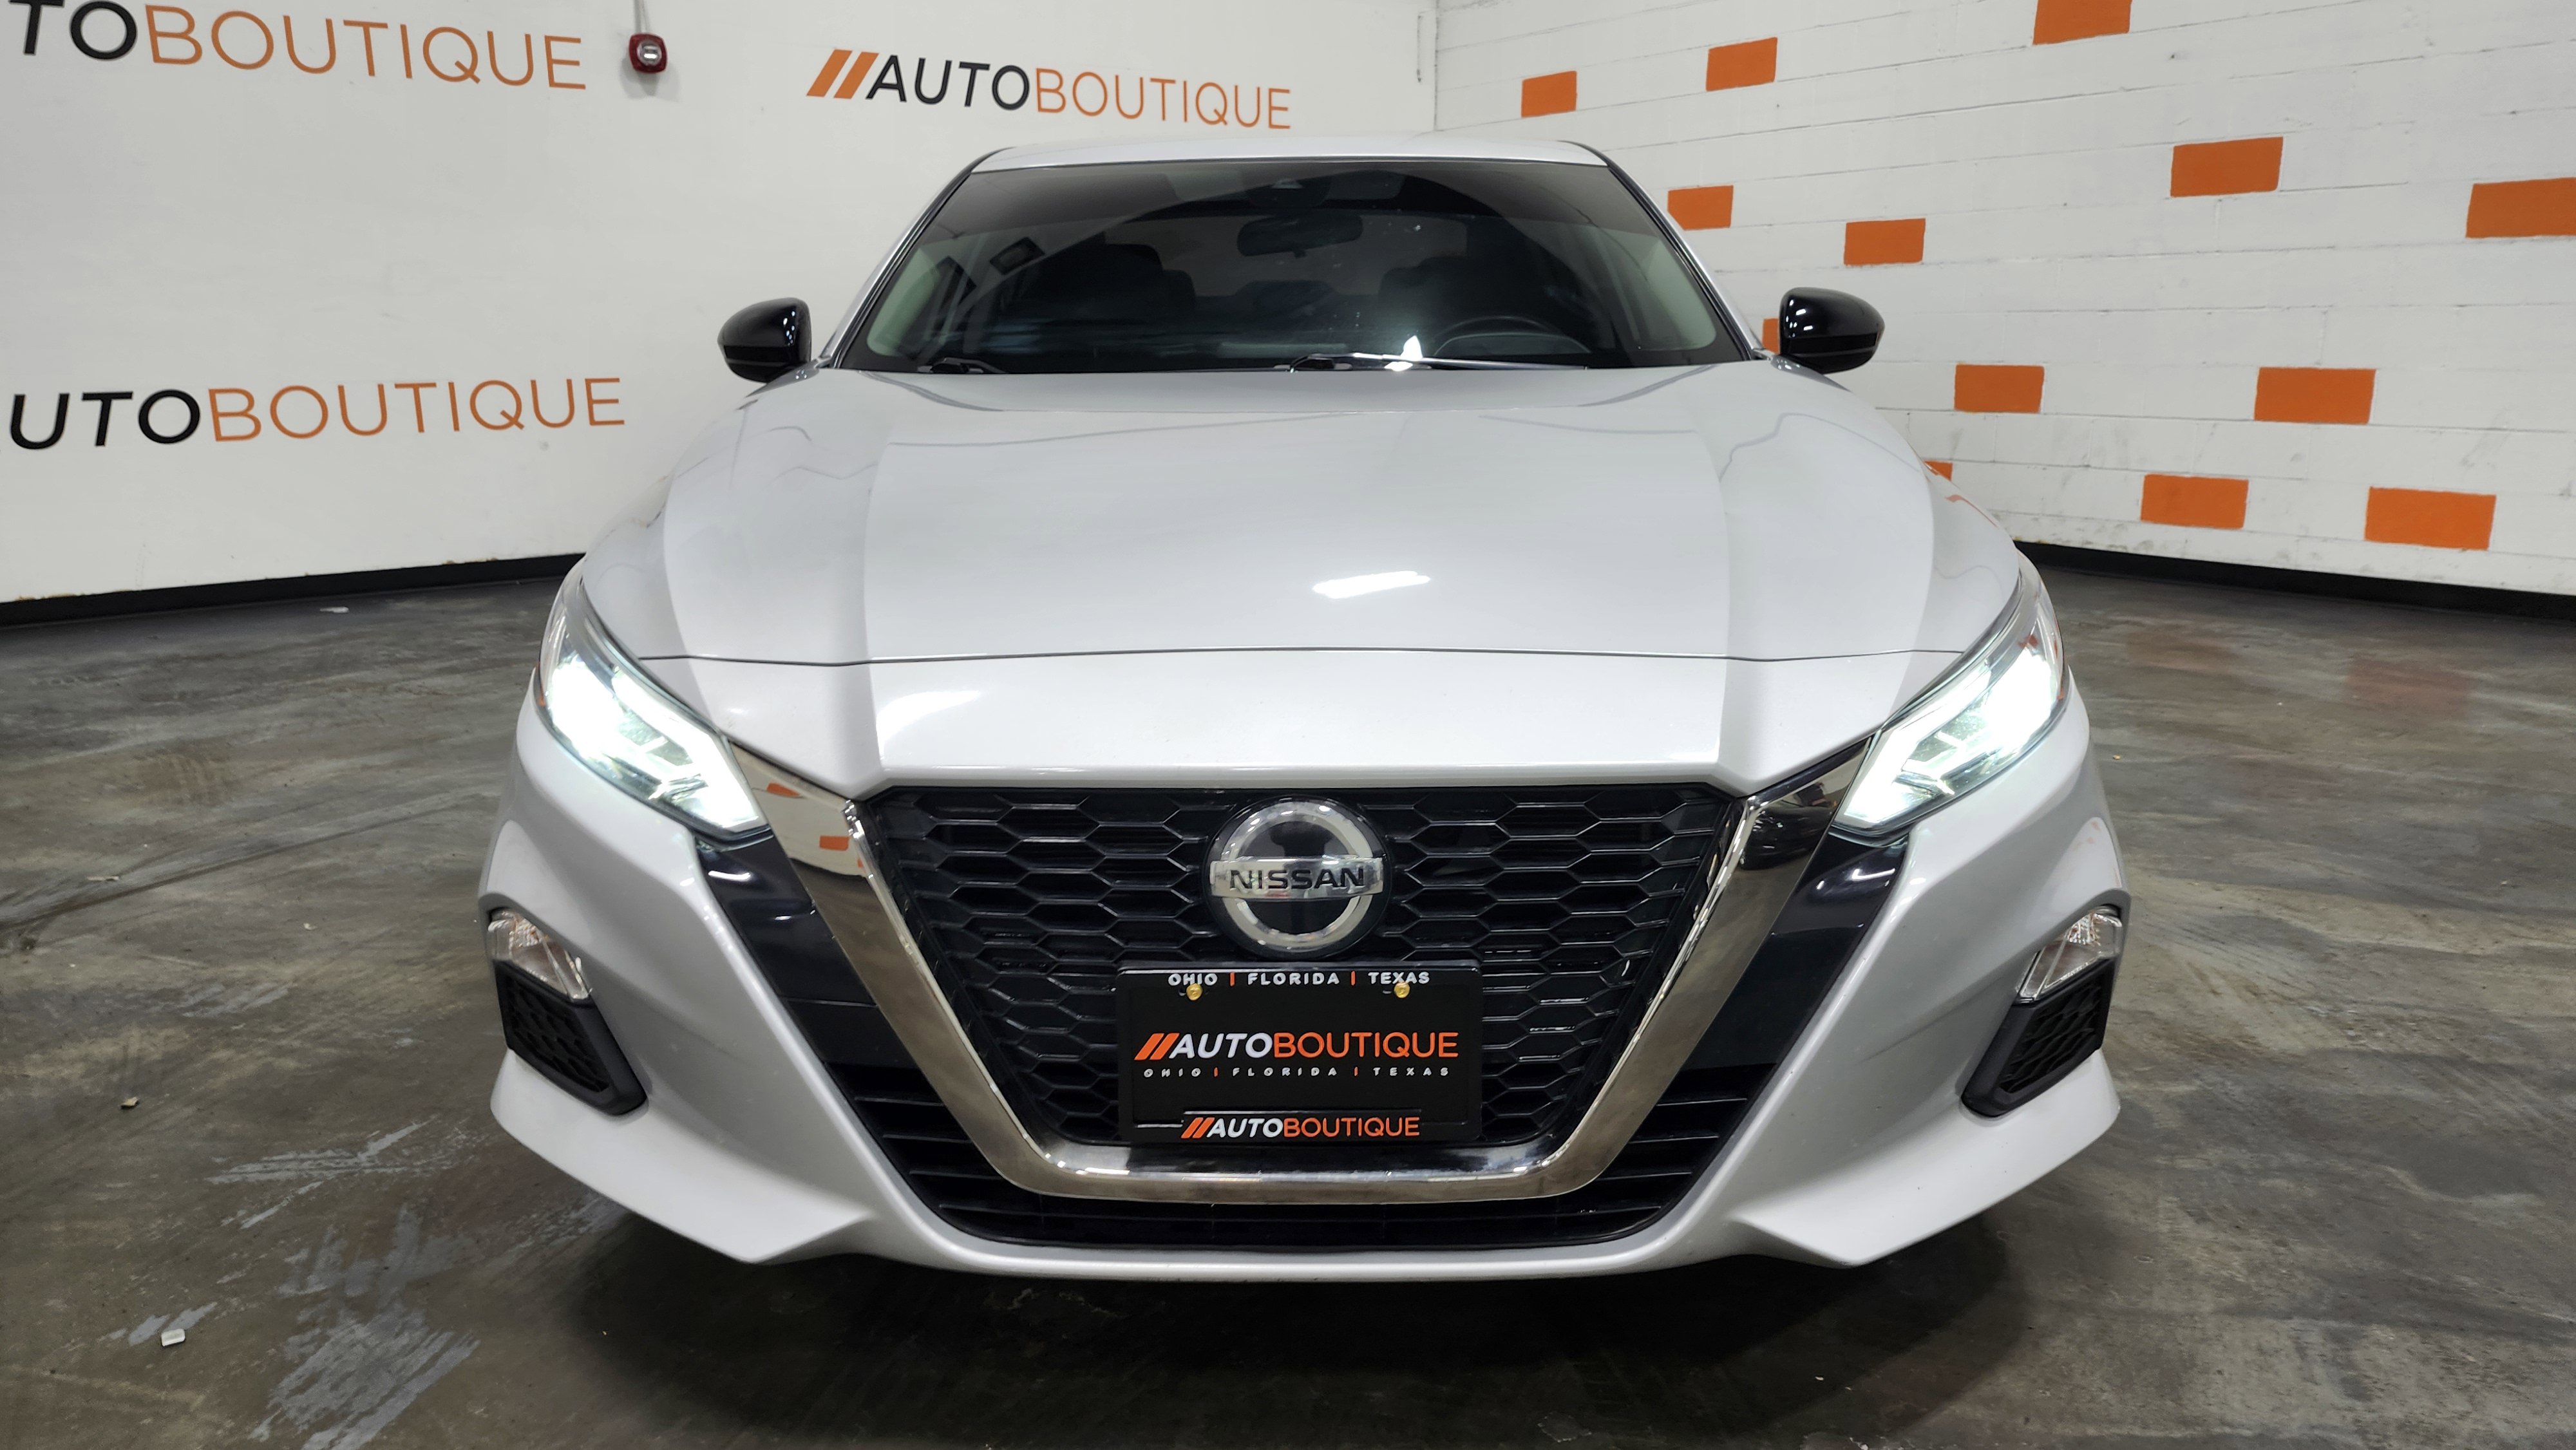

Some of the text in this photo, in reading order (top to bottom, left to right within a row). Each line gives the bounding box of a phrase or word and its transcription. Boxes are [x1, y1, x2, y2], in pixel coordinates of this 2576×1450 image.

[865, 54, 1291, 130] AUTOBOUTIQUE
[9, 377, 625, 450] UTOBOUTIQUE
[1229, 867, 1366, 889] NISSAN
[1168, 972, 1430, 986] OHIO FLORIDA TEXAS
[1168, 1031, 1459, 1059] AUTOBOUTIQUE
[1144, 1067, 1449, 1078] OHIO FLORIDA TEXAS
[1206, 1117, 1419, 1138] AUTOBOUTIQUE
